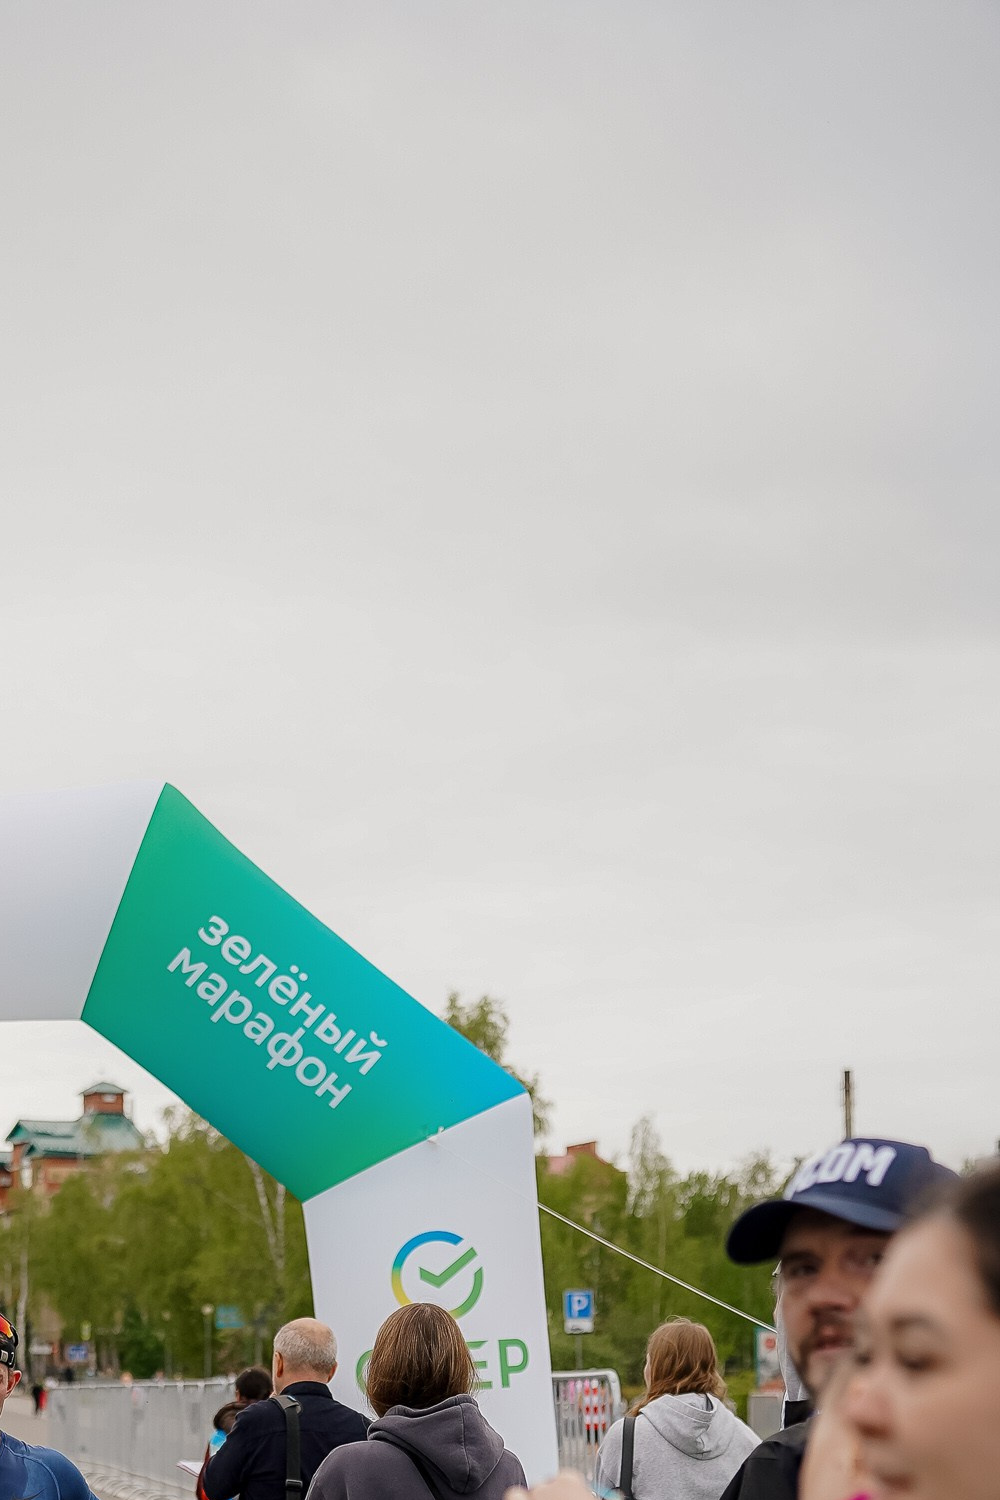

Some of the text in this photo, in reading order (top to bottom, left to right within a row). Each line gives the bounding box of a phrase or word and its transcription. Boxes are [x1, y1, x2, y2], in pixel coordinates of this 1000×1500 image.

[166, 946, 353, 1109] марафон
[197, 915, 388, 1076] зелёный
[571, 1295, 588, 1317] P
